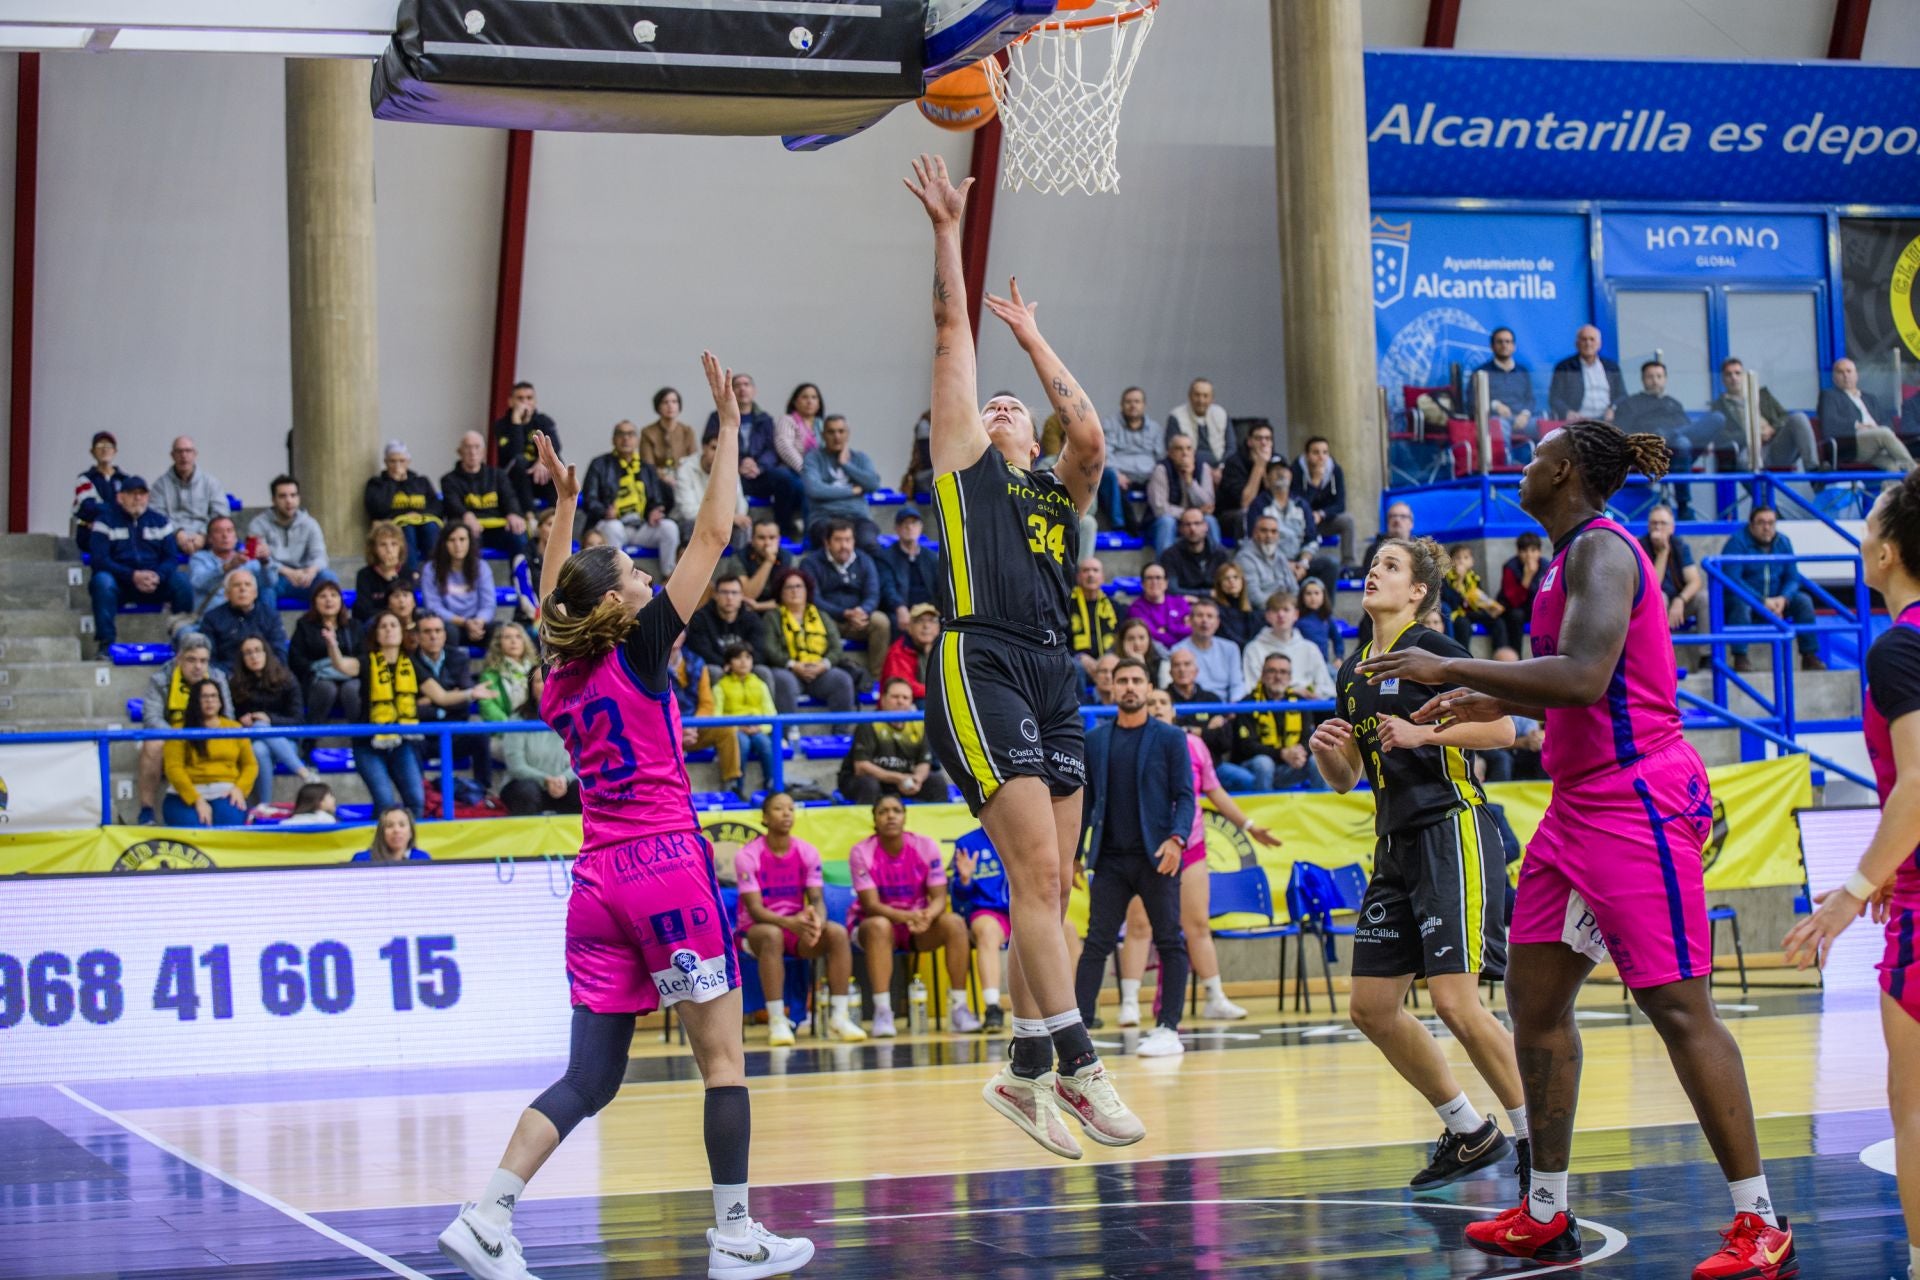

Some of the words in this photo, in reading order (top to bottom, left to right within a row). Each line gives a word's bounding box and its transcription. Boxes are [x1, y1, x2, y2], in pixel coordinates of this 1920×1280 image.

[1368, 103, 1692, 152] Alcantarilla
[1708, 122, 1768, 152] es
[1782, 112, 1920, 165] depo
[1646, 224, 1779, 250] HOZONO
[1443, 256, 1535, 272] Ayuntamiento
[1536, 257, 1555, 271] de
[1696, 255, 1737, 268] GLOBAL
[1412, 273, 1556, 299] Alcantarilla
[1027, 513, 1065, 565] 34
[1009, 748, 1035, 758] Costa
[1371, 750, 1386, 789] 2
[615, 833, 692, 873] CICAR
[1371, 928, 1399, 938] Cálida
[153, 944, 233, 1020] 41
[259, 939, 355, 1016] 60
[379, 935, 461, 1012] 15
